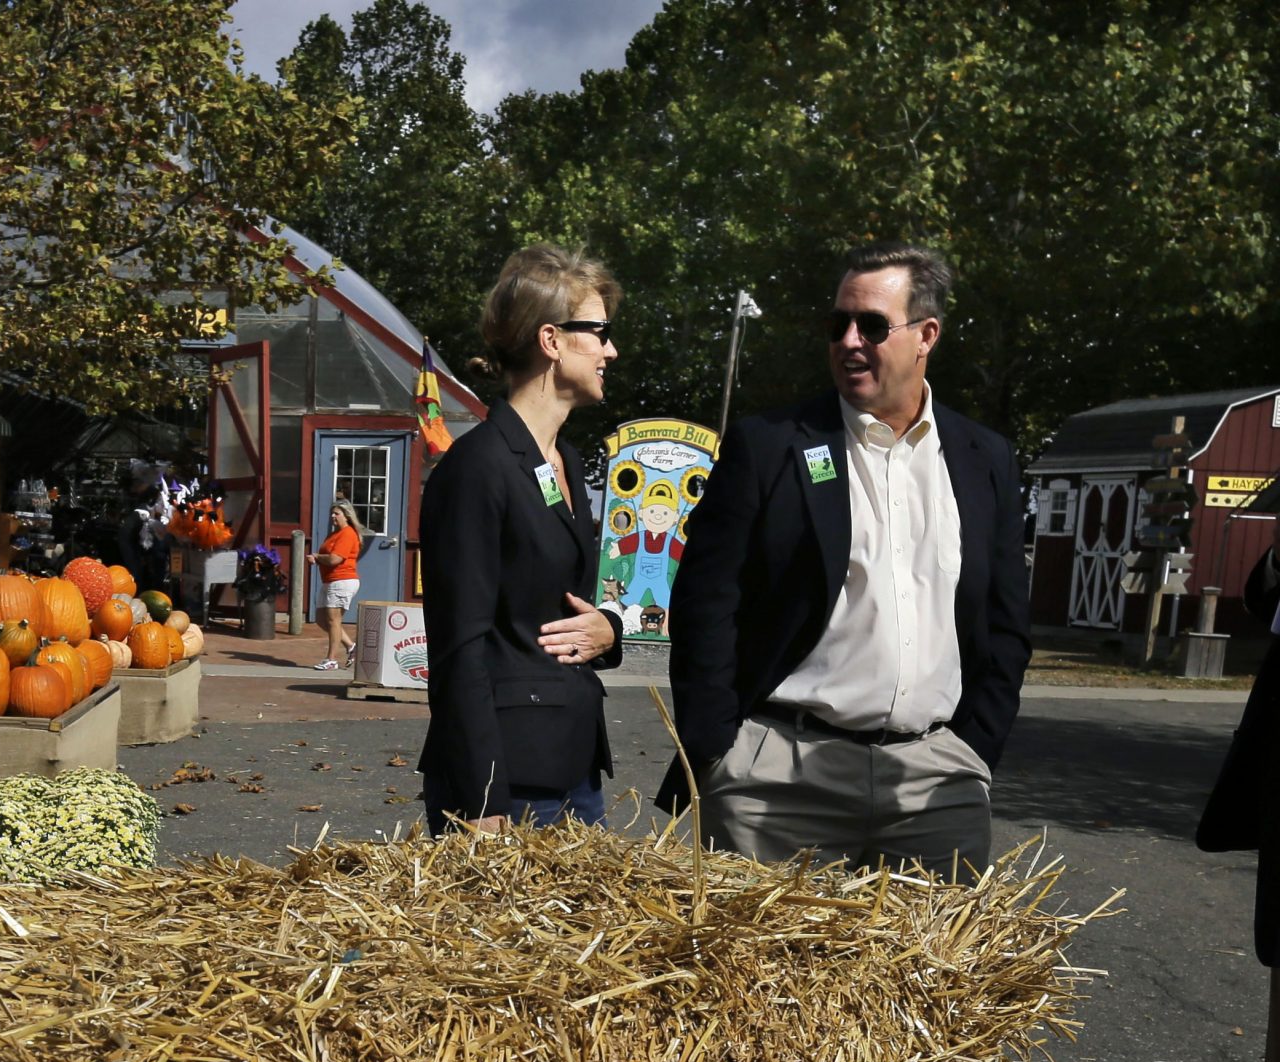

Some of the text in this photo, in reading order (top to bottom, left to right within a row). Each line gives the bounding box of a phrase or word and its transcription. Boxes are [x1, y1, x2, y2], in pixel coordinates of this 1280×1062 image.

[626, 426, 708, 446] Barnyard Bill
[637, 447, 696, 460] Johnson's Corner
[806, 450, 828, 459] Keep
[652, 456, 673, 465] Farm
[538, 469, 552, 479] Keep
[811, 470, 835, 480] Green
